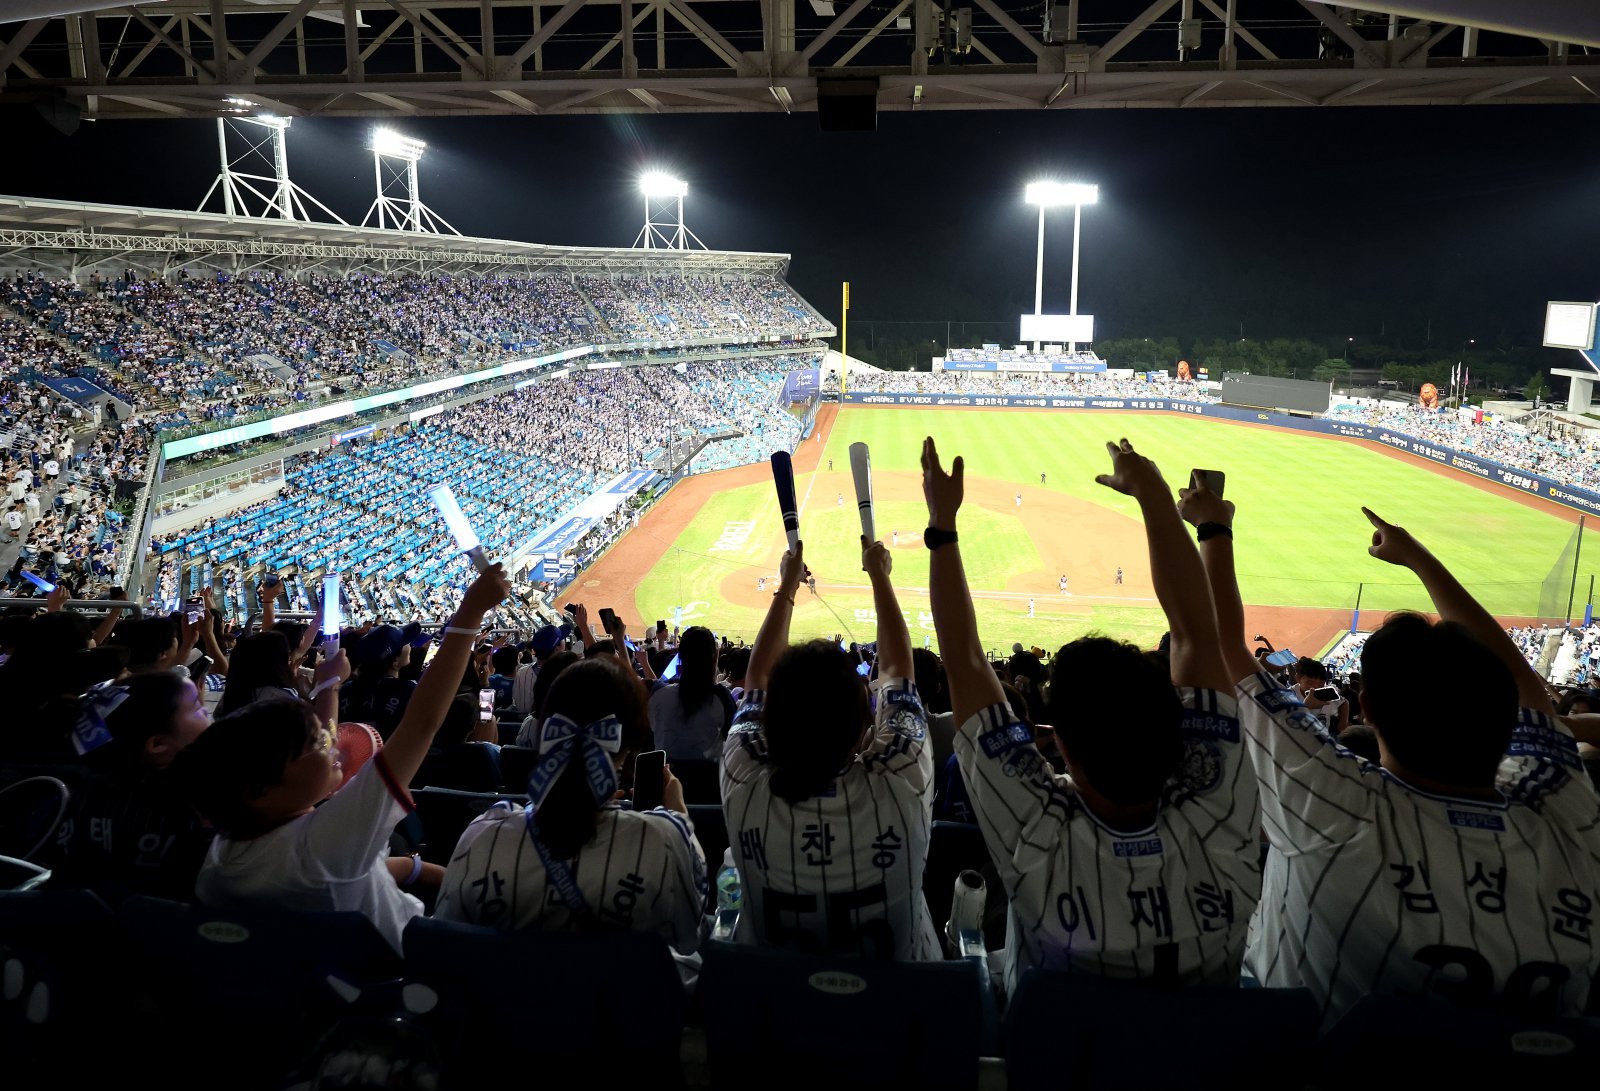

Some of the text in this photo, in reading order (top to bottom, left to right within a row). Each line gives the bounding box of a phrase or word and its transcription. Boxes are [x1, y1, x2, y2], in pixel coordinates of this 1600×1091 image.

[1171, 402, 1202, 414] 대방건설
[1332, 424, 1373, 433] VOLVO
[708, 520, 757, 551] TERRA
[738, 823, 902, 871] 배찬승
[1116, 839, 1162, 857] 삼성카드
[1057, 882, 1235, 941] 이재현
[1390, 861, 1594, 945] 김성윤
